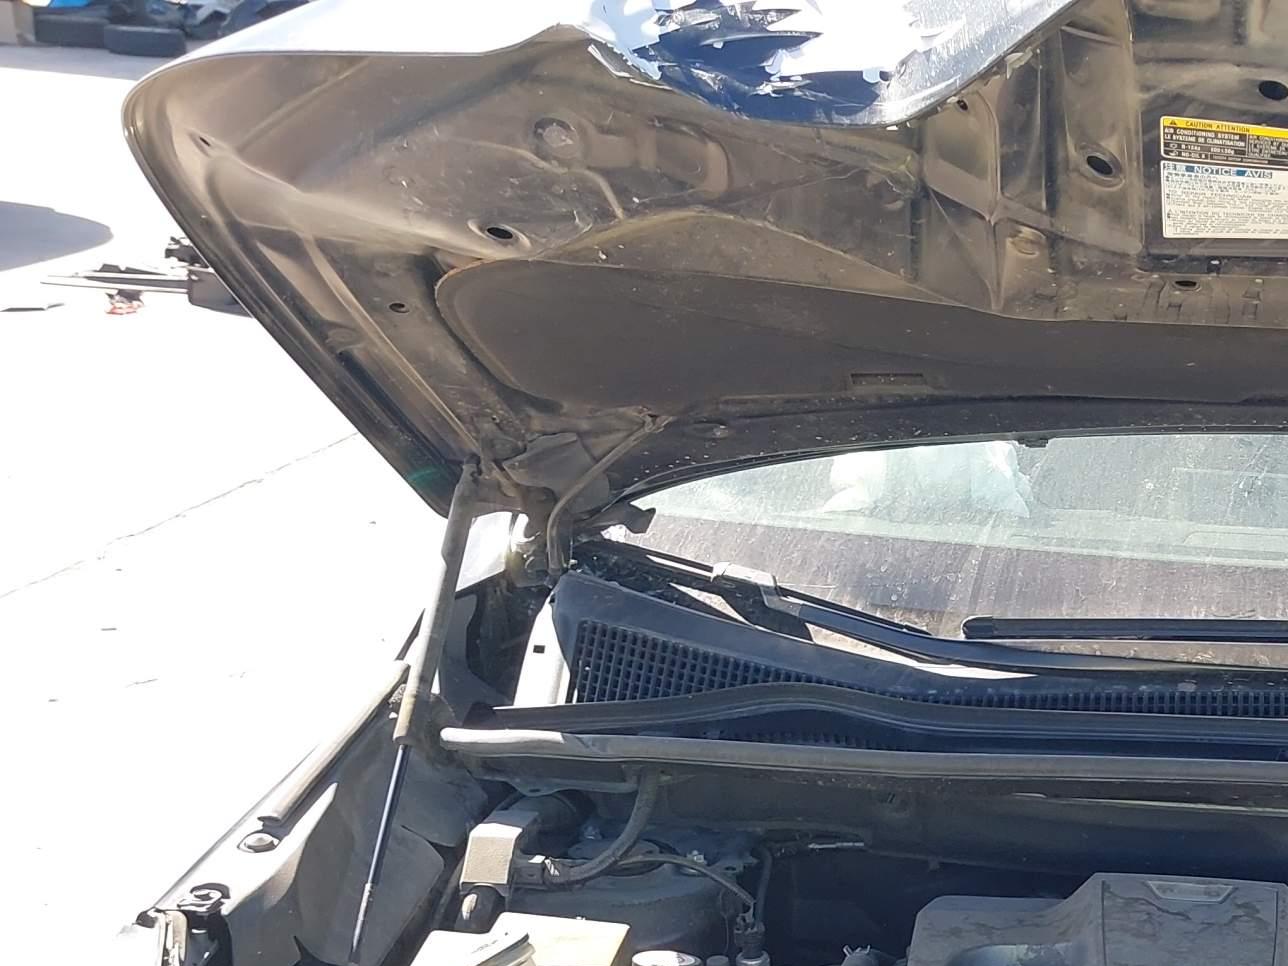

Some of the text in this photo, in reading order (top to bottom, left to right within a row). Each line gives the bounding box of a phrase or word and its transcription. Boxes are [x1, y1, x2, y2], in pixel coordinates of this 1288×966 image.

[1186, 121, 1250, 133] CAUTION ATTENTION
[1177, 129, 1215, 138] CONDITIONING
[1194, 165, 1272, 179] NOTICE AVIS
